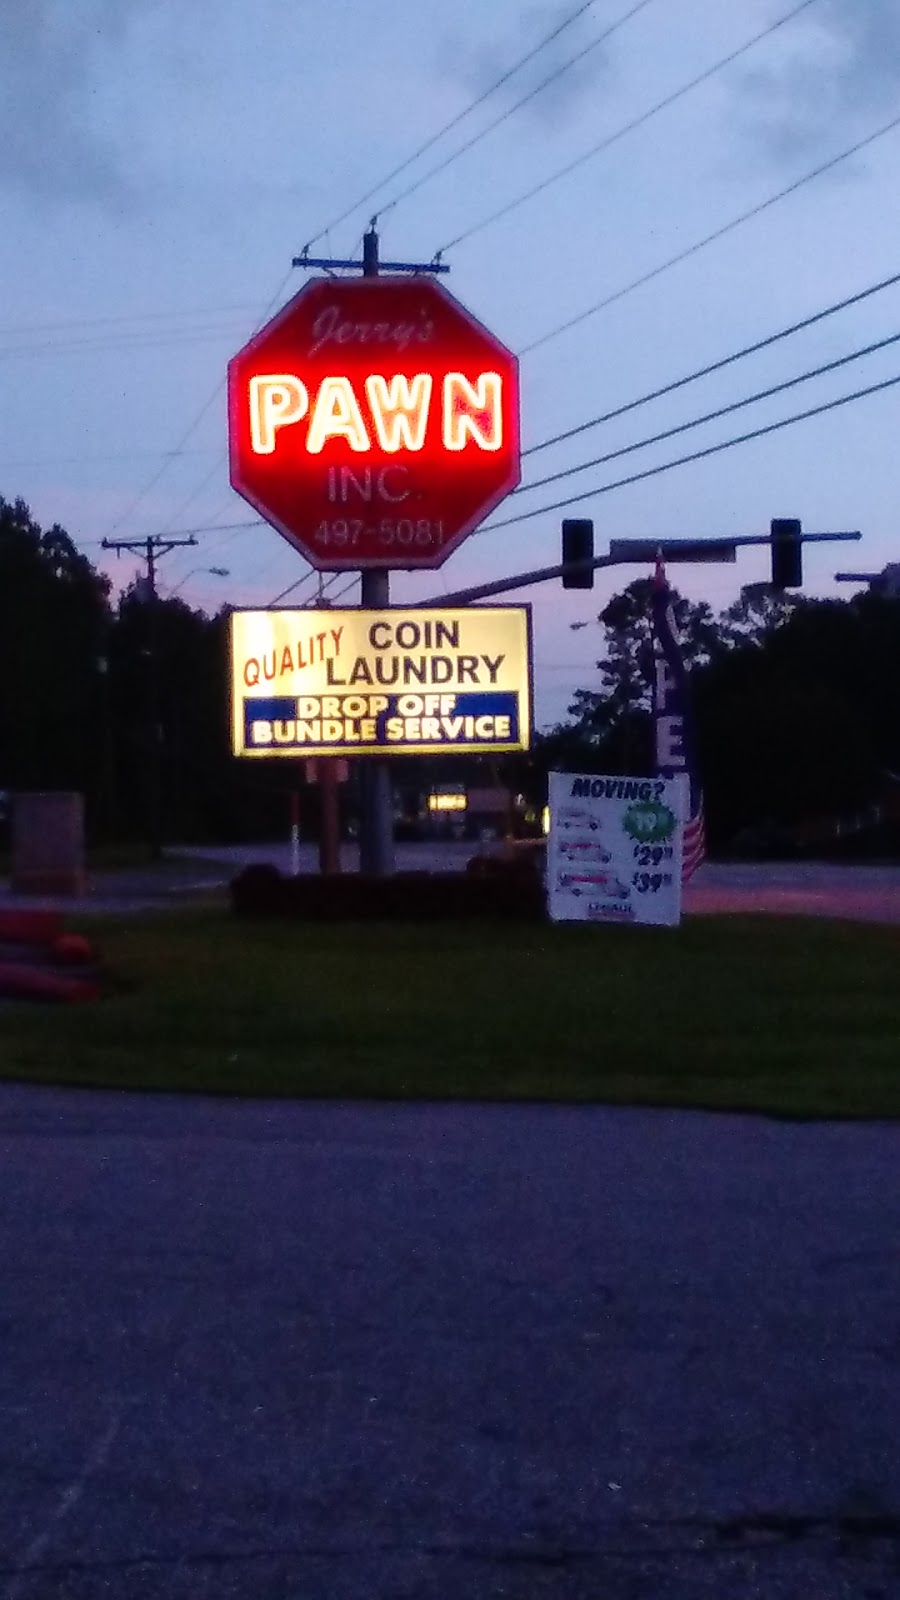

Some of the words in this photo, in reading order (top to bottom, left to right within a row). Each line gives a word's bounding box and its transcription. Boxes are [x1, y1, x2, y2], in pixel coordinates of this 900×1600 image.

[306, 305, 436, 360] Jerry's
[249, 371, 503, 455] PAWN
[314, 519, 444, 546] 497-5081
[369, 620, 460, 649] COIN
[243, 626, 344, 687] QUALITY
[326, 654, 506, 686] LAUNDRY
[296, 696, 388, 719] DROP
[397, 695, 457, 717] OFF
[252, 719, 377, 743] BUNDLE
[386, 716, 511, 741] SERVICE
[570, 778, 665, 800] MOVING?
